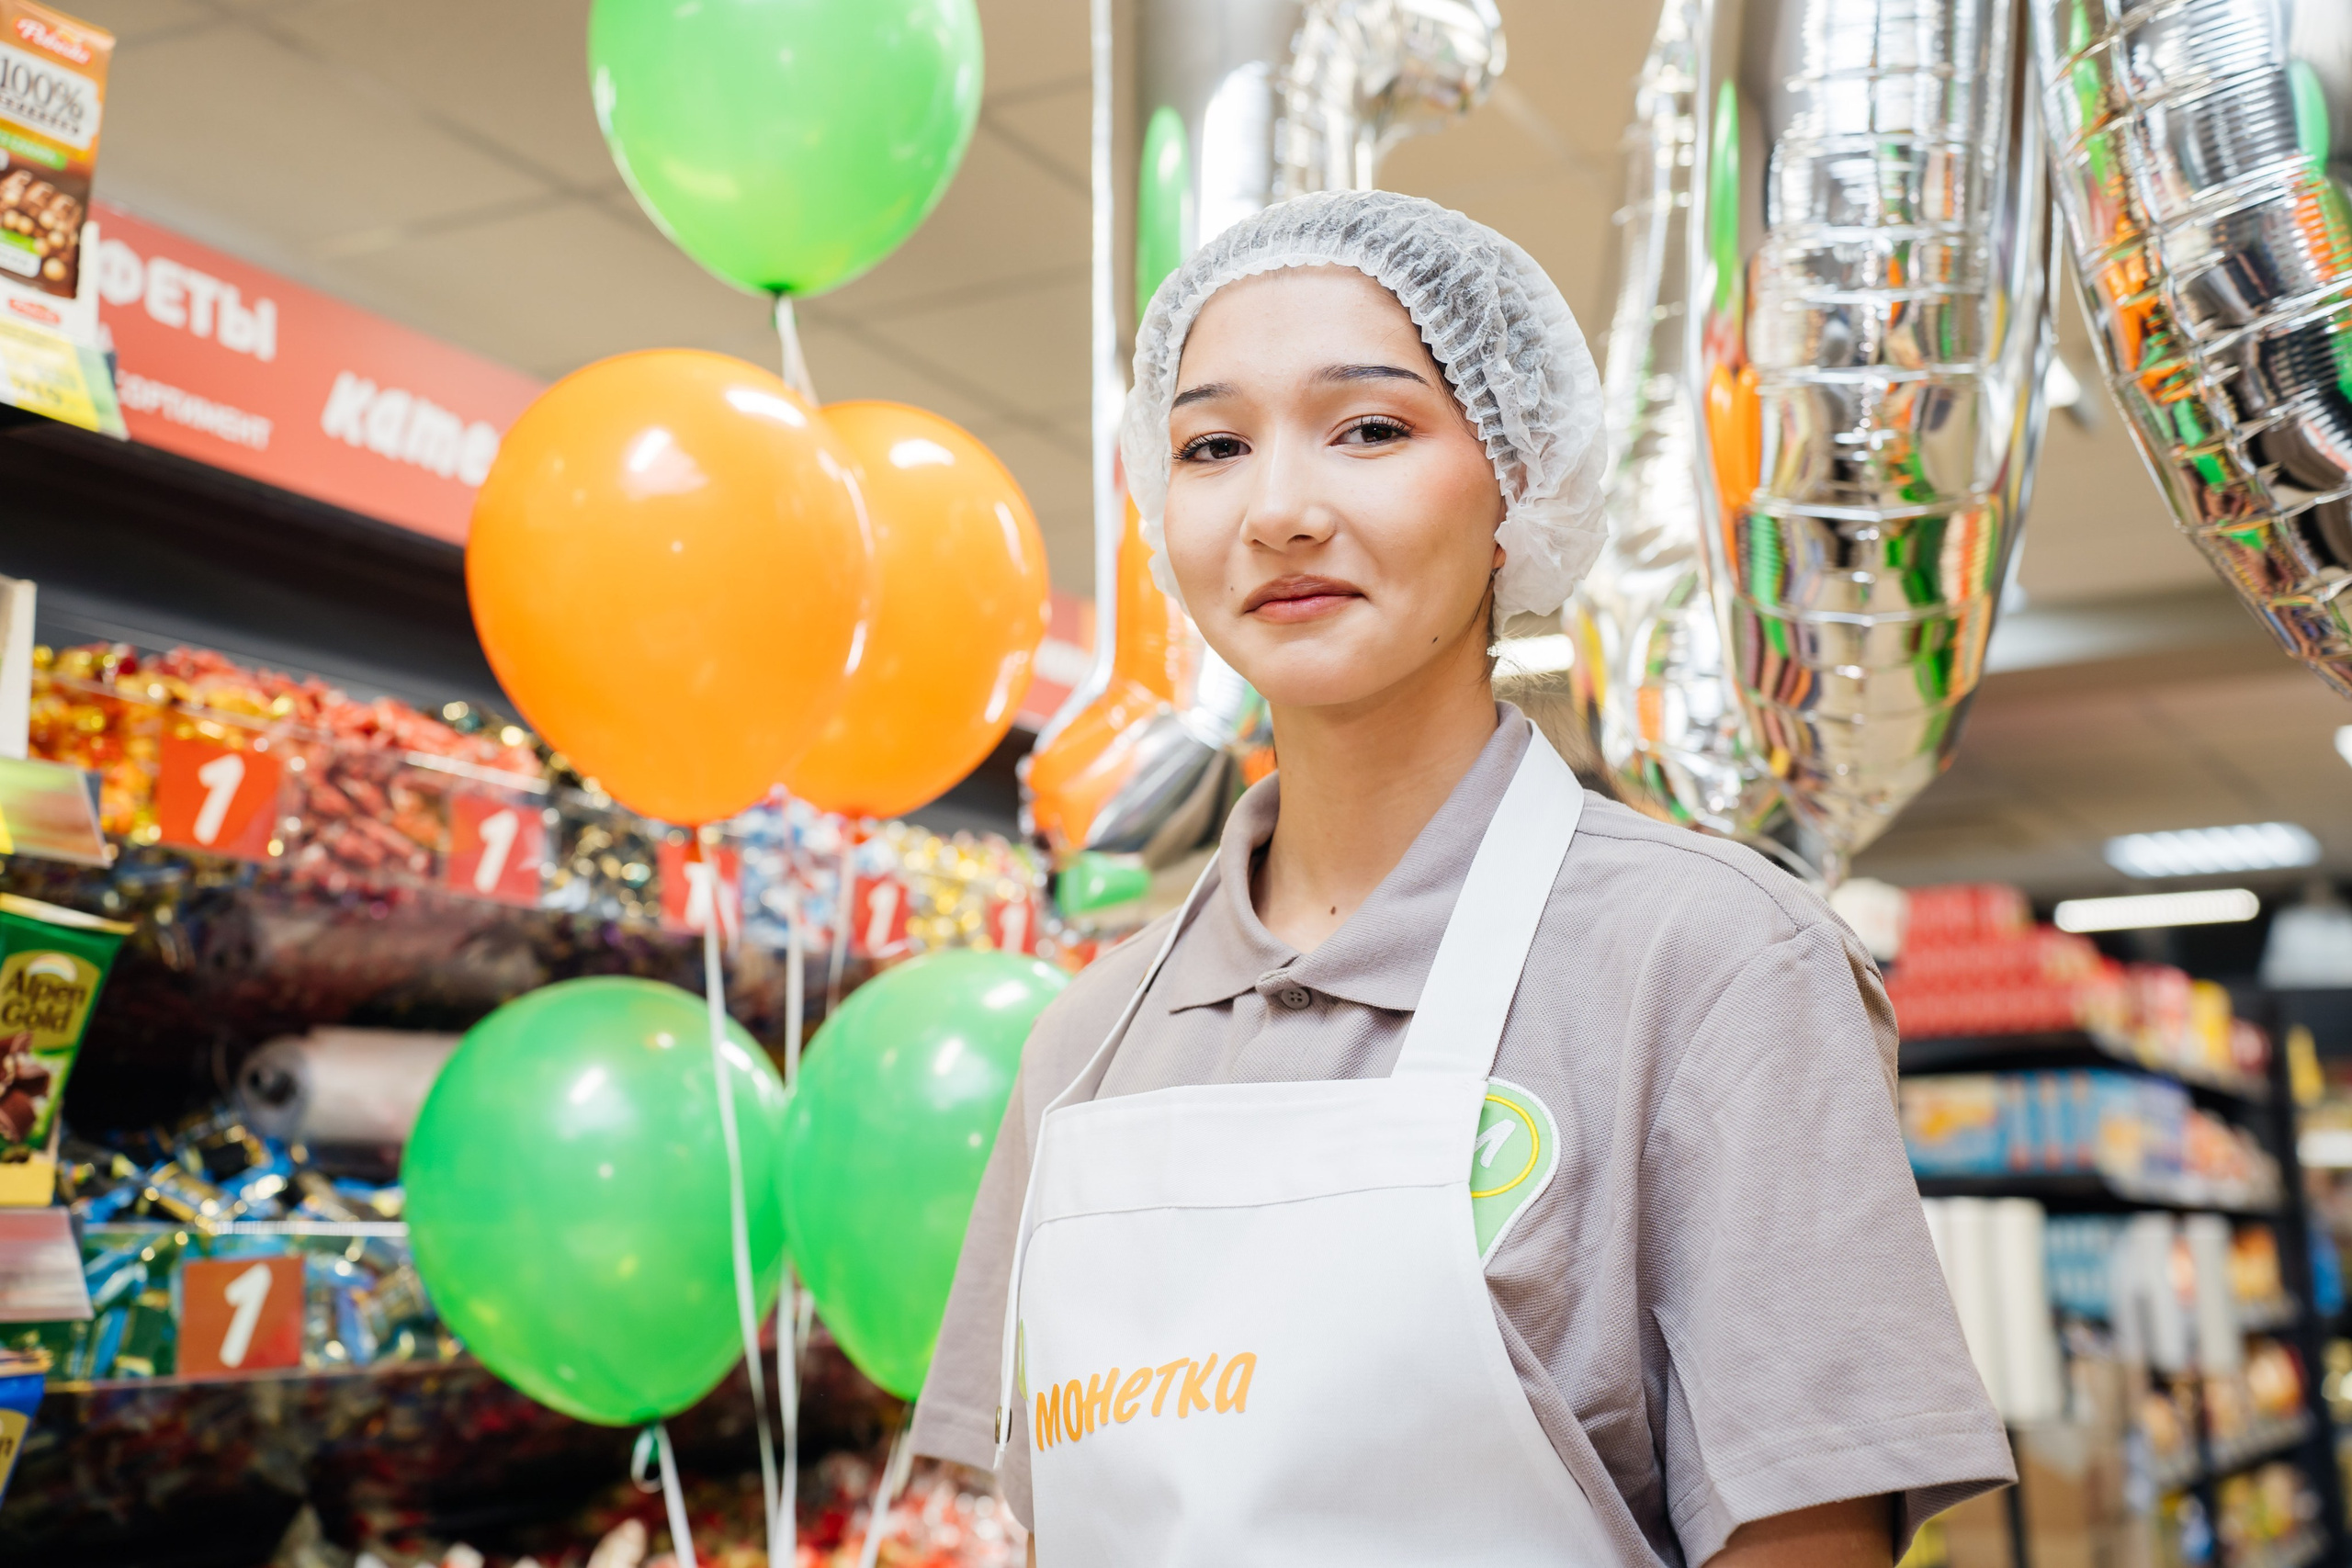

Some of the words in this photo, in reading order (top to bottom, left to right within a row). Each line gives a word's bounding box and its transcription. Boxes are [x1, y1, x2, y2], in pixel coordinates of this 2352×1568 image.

[0, 58, 83, 119] 100%
[193, 753, 244, 845] 1
[473, 808, 519, 894] 1
[1, 968, 86, 1009] Alpen
[2, 997, 74, 1033] Gold
[219, 1262, 273, 1369] 1
